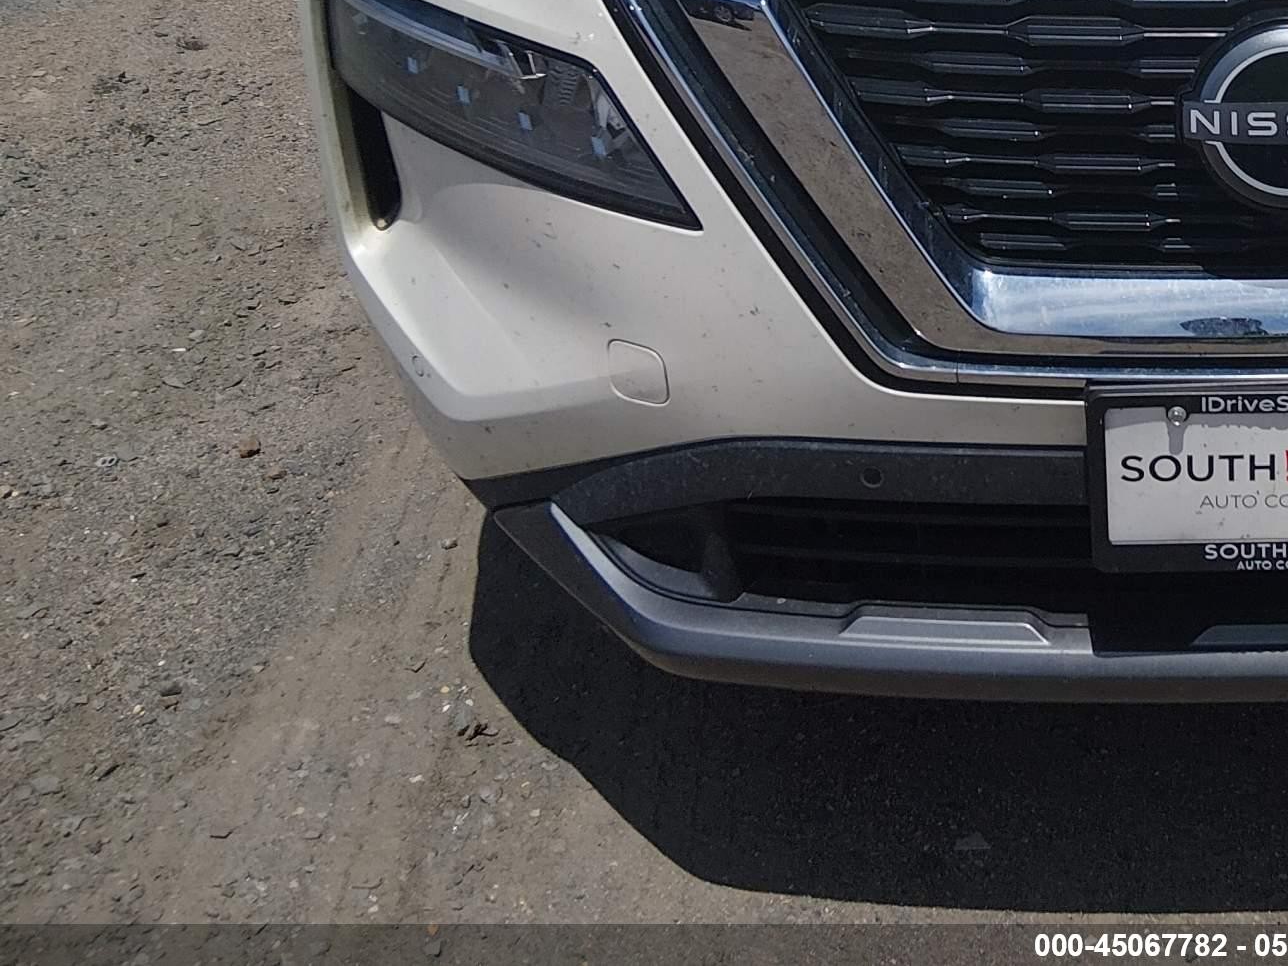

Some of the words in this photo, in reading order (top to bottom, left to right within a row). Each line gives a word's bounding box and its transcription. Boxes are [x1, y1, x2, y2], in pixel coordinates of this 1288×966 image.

[1120, 453, 1277, 483] SOUTH
[1199, 493, 1259, 510] AUTO
[1204, 543, 1288, 561] SOUTH
[1236, 559, 1283, 571] AUTO
